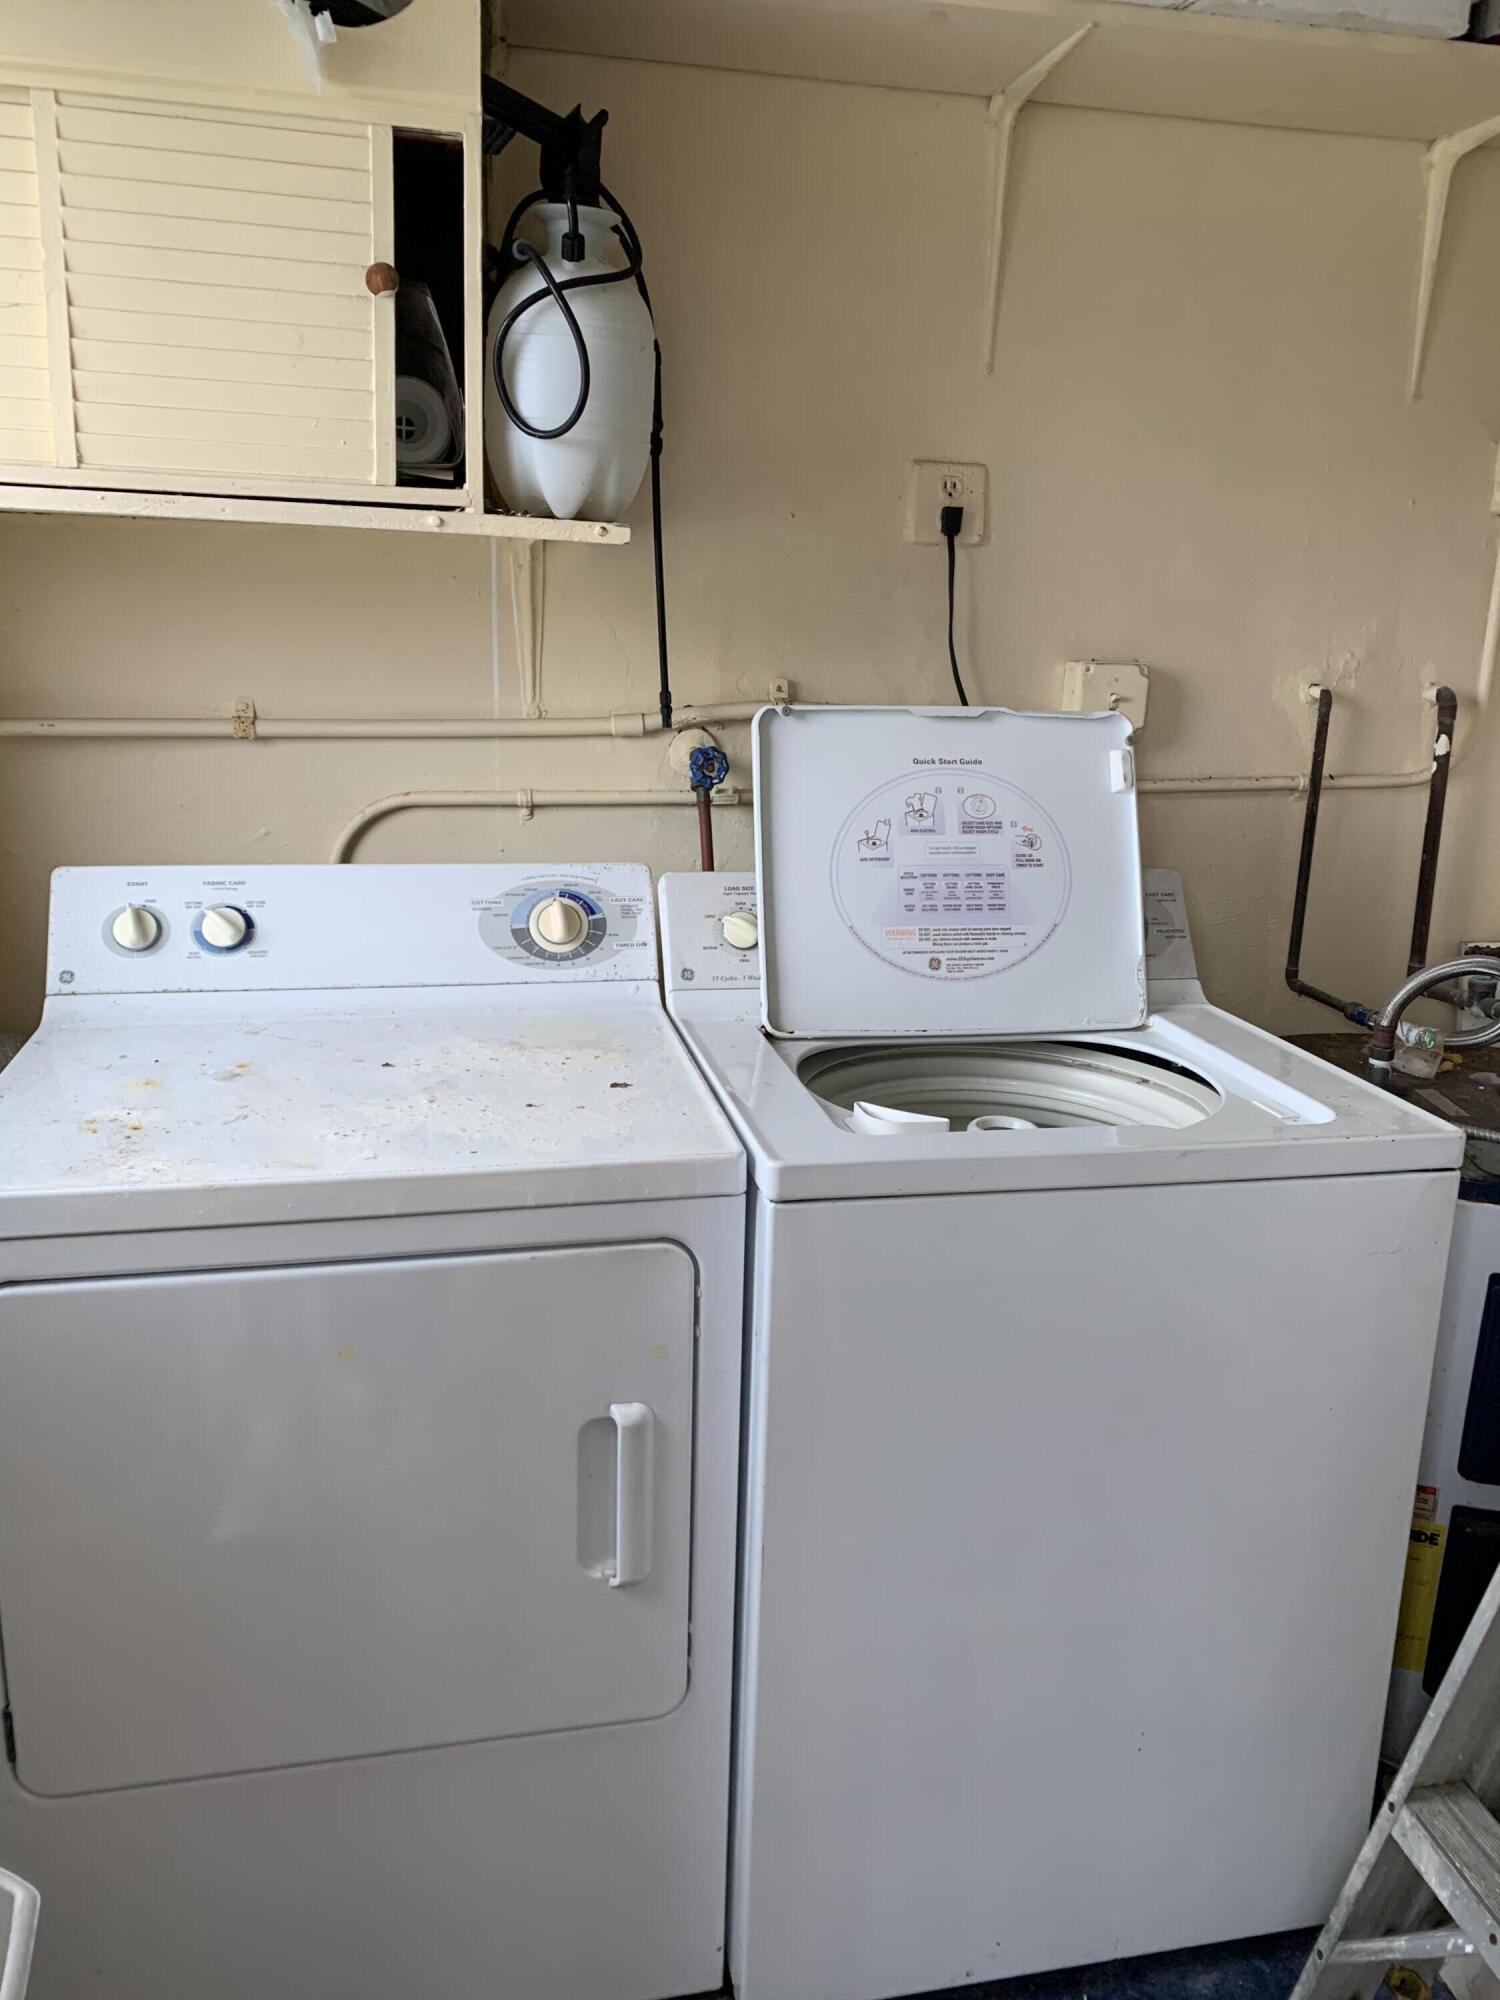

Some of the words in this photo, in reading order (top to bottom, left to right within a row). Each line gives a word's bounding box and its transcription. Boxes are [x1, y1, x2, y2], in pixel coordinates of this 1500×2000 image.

[912, 757, 936, 765] Quick
[938, 757, 958, 765] Start
[960, 757, 983, 765] Guide
